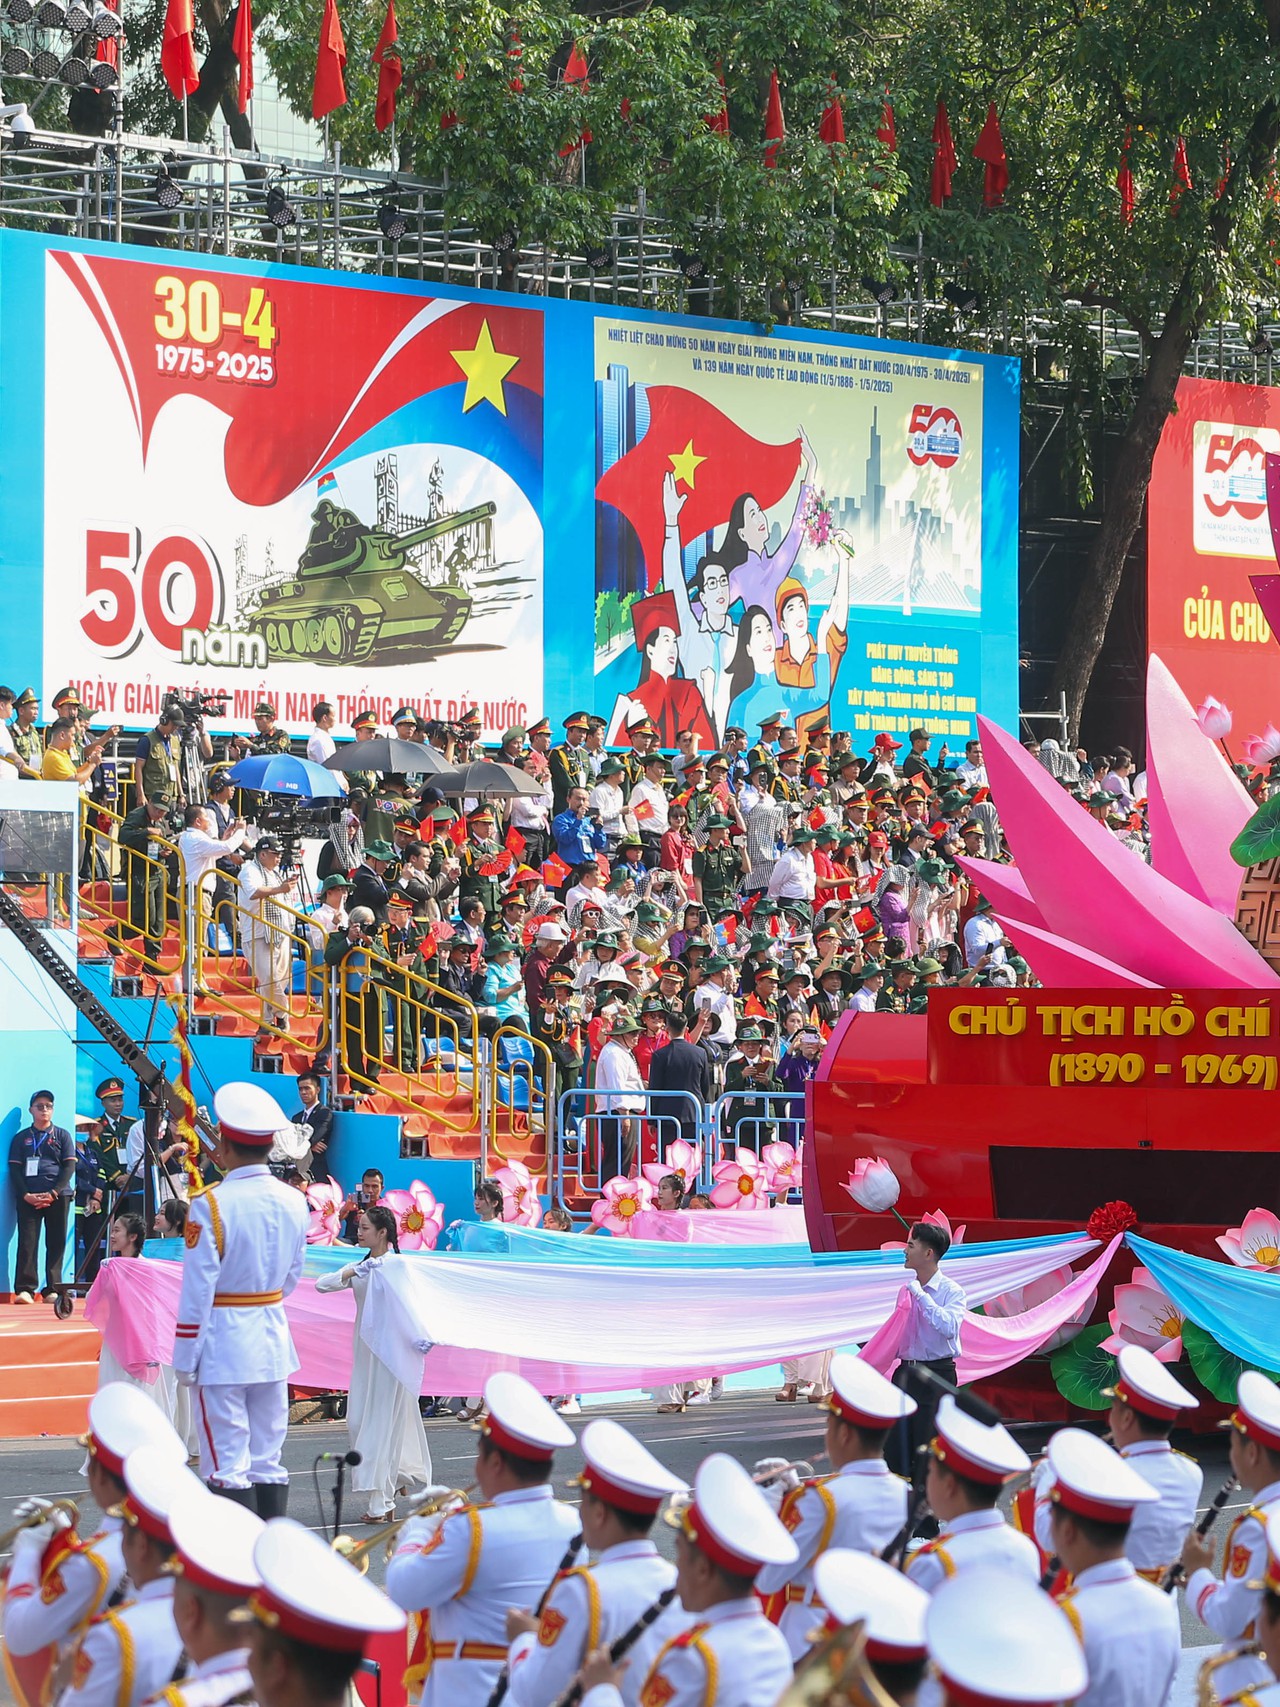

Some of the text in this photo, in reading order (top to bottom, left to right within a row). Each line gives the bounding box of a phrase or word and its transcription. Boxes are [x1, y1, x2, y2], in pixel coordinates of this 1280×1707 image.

[154, 275, 277, 351] 30-4
[608, 328, 628, 345] NHIỆT
[630, 329, 644, 346] LIỆT
[645, 331, 665, 347] CHÀO
[666, 333, 687, 350] MỪNG
[688, 337, 698, 351] 50
[700, 337, 716, 353] NĂM
[717, 339, 735, 355] NGÀY
[737, 342, 752, 357] GIẢI
[753, 344, 777, 360] PHÓNG
[779, 345, 796, 363] MIỀN
[798, 351, 814, 366] NAM,
[816, 350, 839, 368] THỐNG
[840, 353, 857, 370] NHẤT
[858, 355, 871, 372] ĐẤT
[873, 358, 892, 375] NƯỚC
[692, 357, 703, 372] VÀ
[704, 359, 717, 374] 139
[718, 360, 735, 376] NĂM
[736, 362, 754, 378] NGÀY
[755, 362, 775, 380] QUỐC
[776, 362, 785, 381] TẾ
[786, 369, 799, 383] LAO
[800, 369, 819, 386] ĐỘNG
[79, 529, 269, 670] 50 năm
[1184, 585, 1226, 641] CỦA
[124, 673, 160, 715] GIẢI
[337, 684, 393, 726] THỐNG
[483, 696, 527, 731] NƯỚC
[285, 782, 299, 790] MB
[949, 997, 1027, 1036] CHỦ
[1036, 1005, 1125, 1042] TỊCH
[1134, 993, 1195, 1036] HỒ
[1205, 998, 1270, 1037] CHÍ
[1049, 1053, 1278, 1090] (1890 - 1969)
